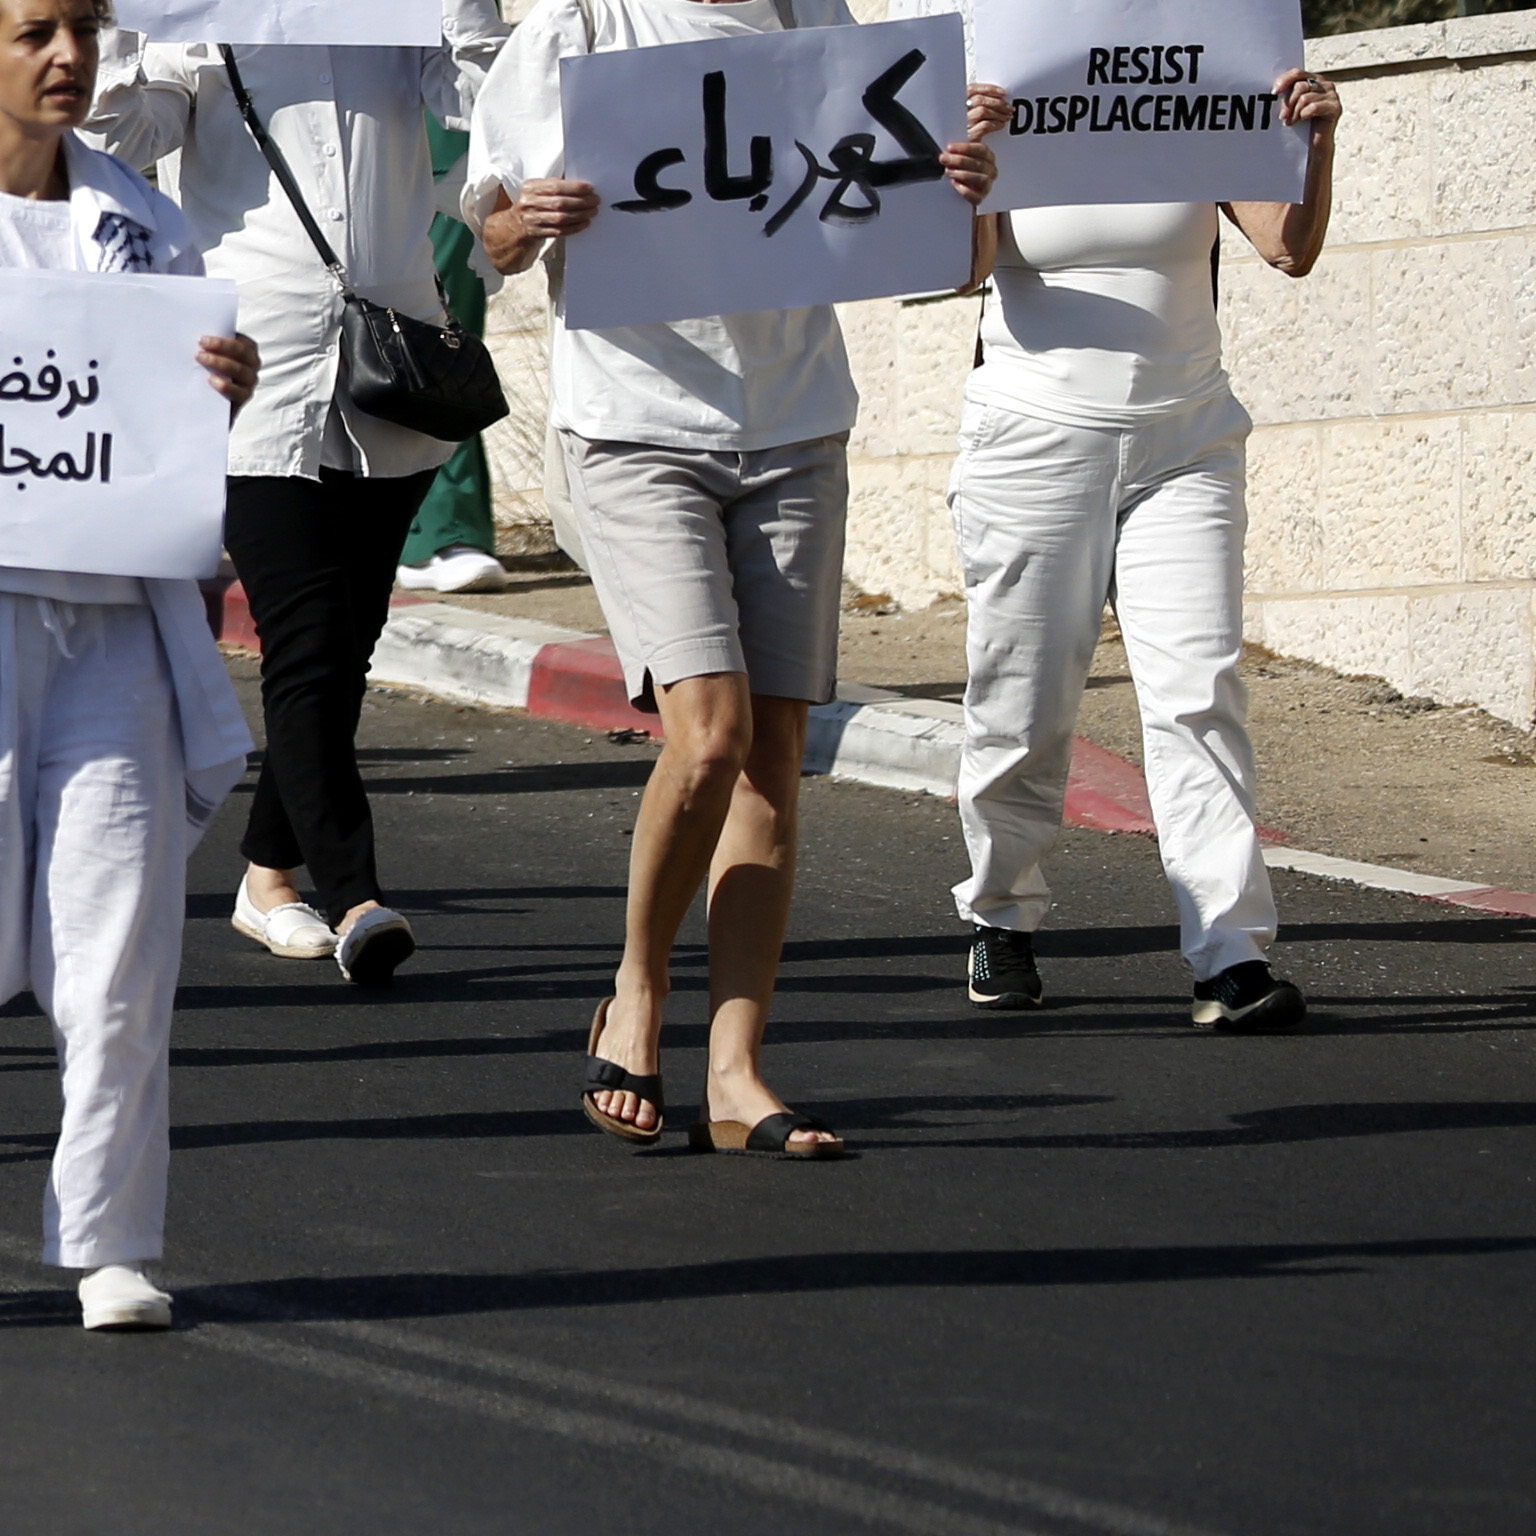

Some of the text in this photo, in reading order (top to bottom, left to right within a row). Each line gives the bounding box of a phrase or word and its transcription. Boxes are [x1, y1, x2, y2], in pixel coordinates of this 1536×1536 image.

[1086, 44, 1204, 86] RESIST
[1010, 92, 1279, 136] DISPLACEMENT
[610, 48, 946, 238] كهرباء
